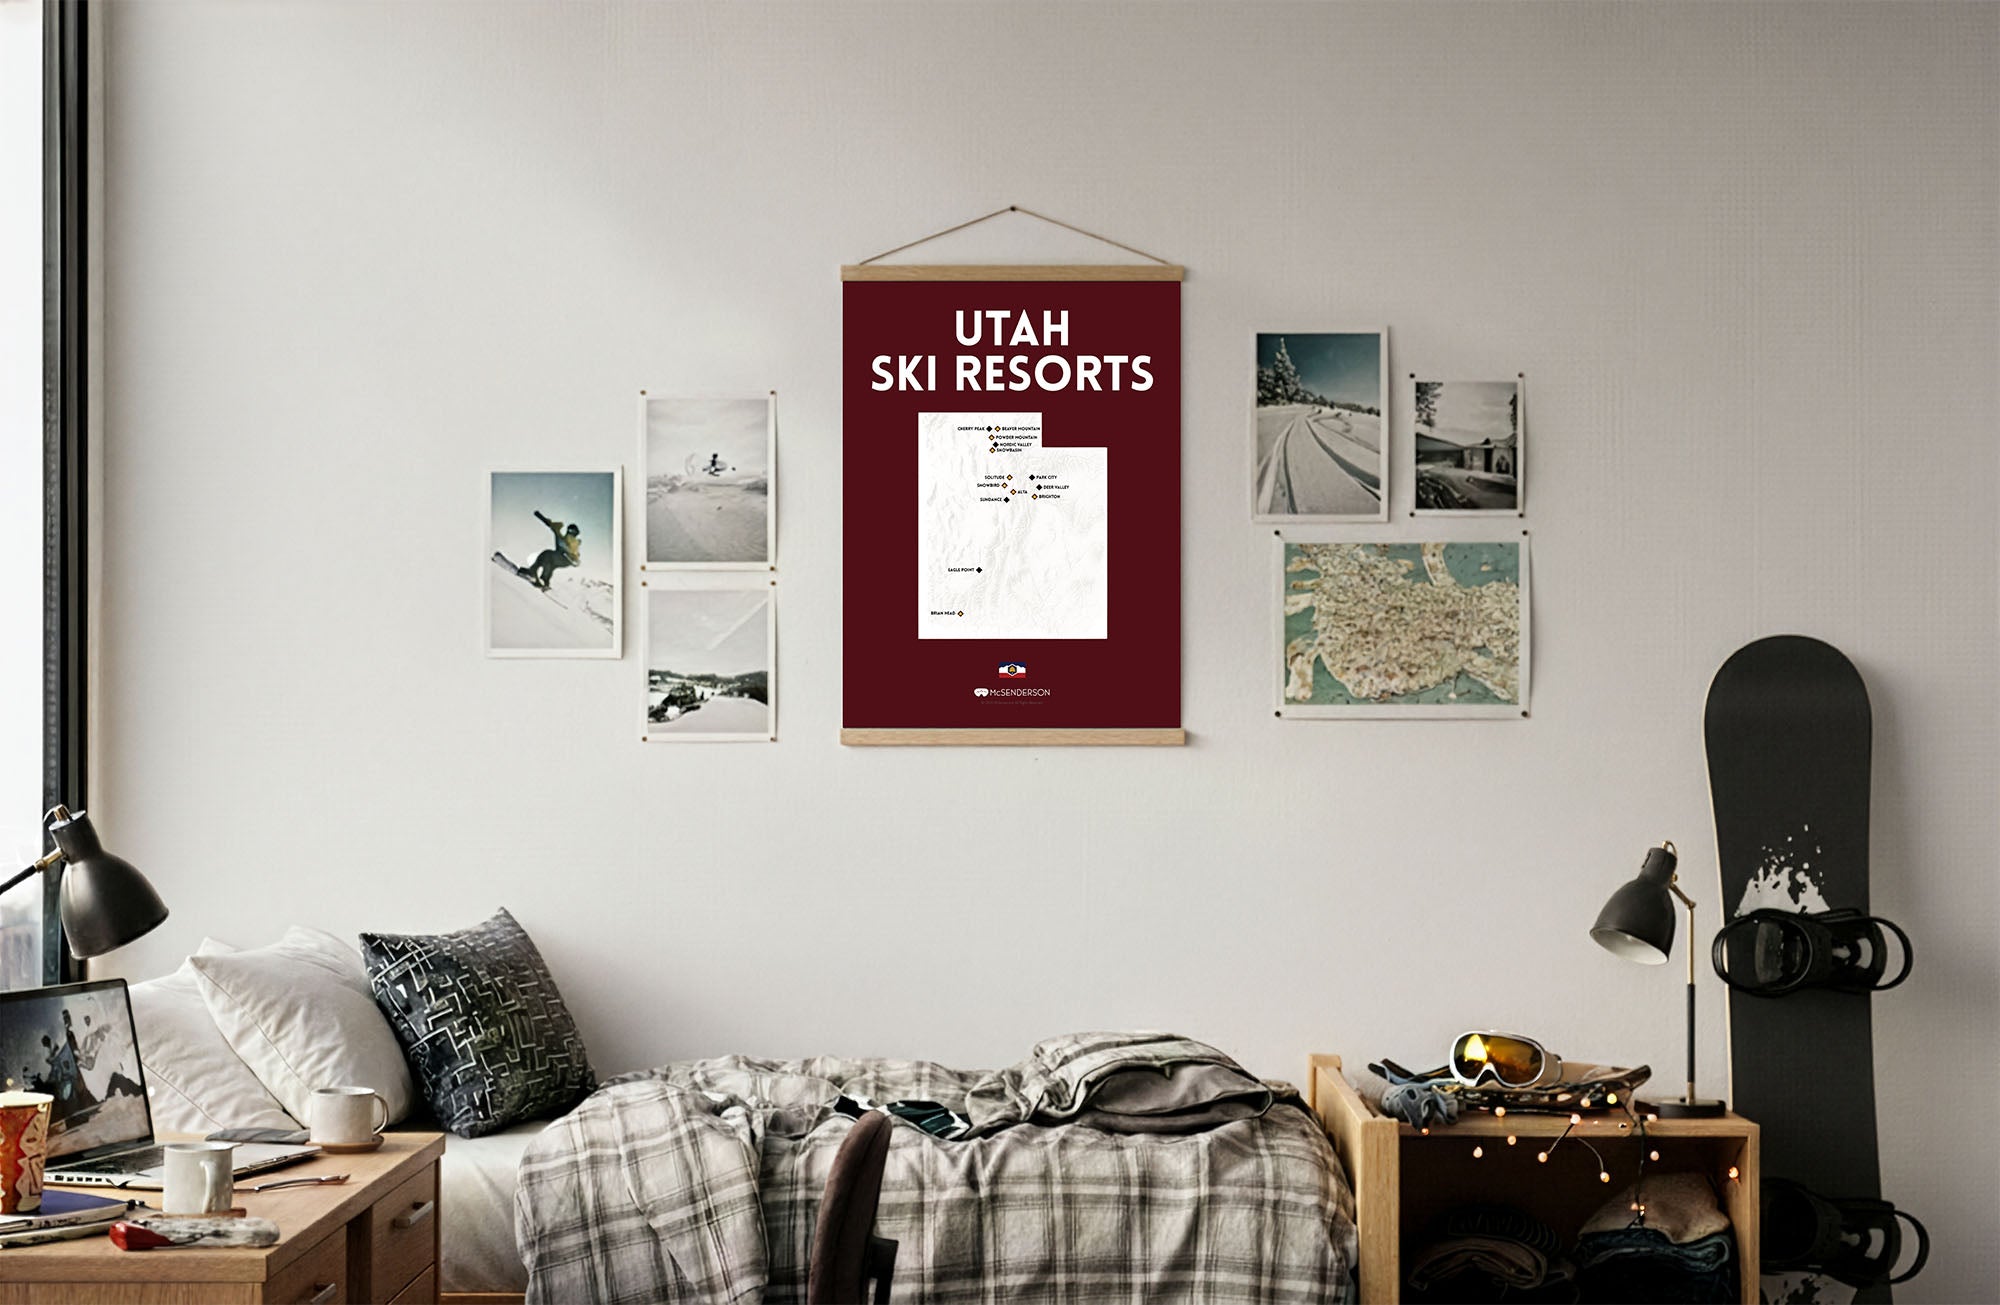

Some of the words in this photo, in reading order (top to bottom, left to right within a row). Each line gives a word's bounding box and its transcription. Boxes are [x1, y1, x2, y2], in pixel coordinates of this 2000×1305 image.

[956, 308, 1069, 346] UTAH
[871, 354, 936, 392] SKI
[956, 354, 1154, 392] RESORTS
[990, 688, 1050, 697] McSENDERSON
